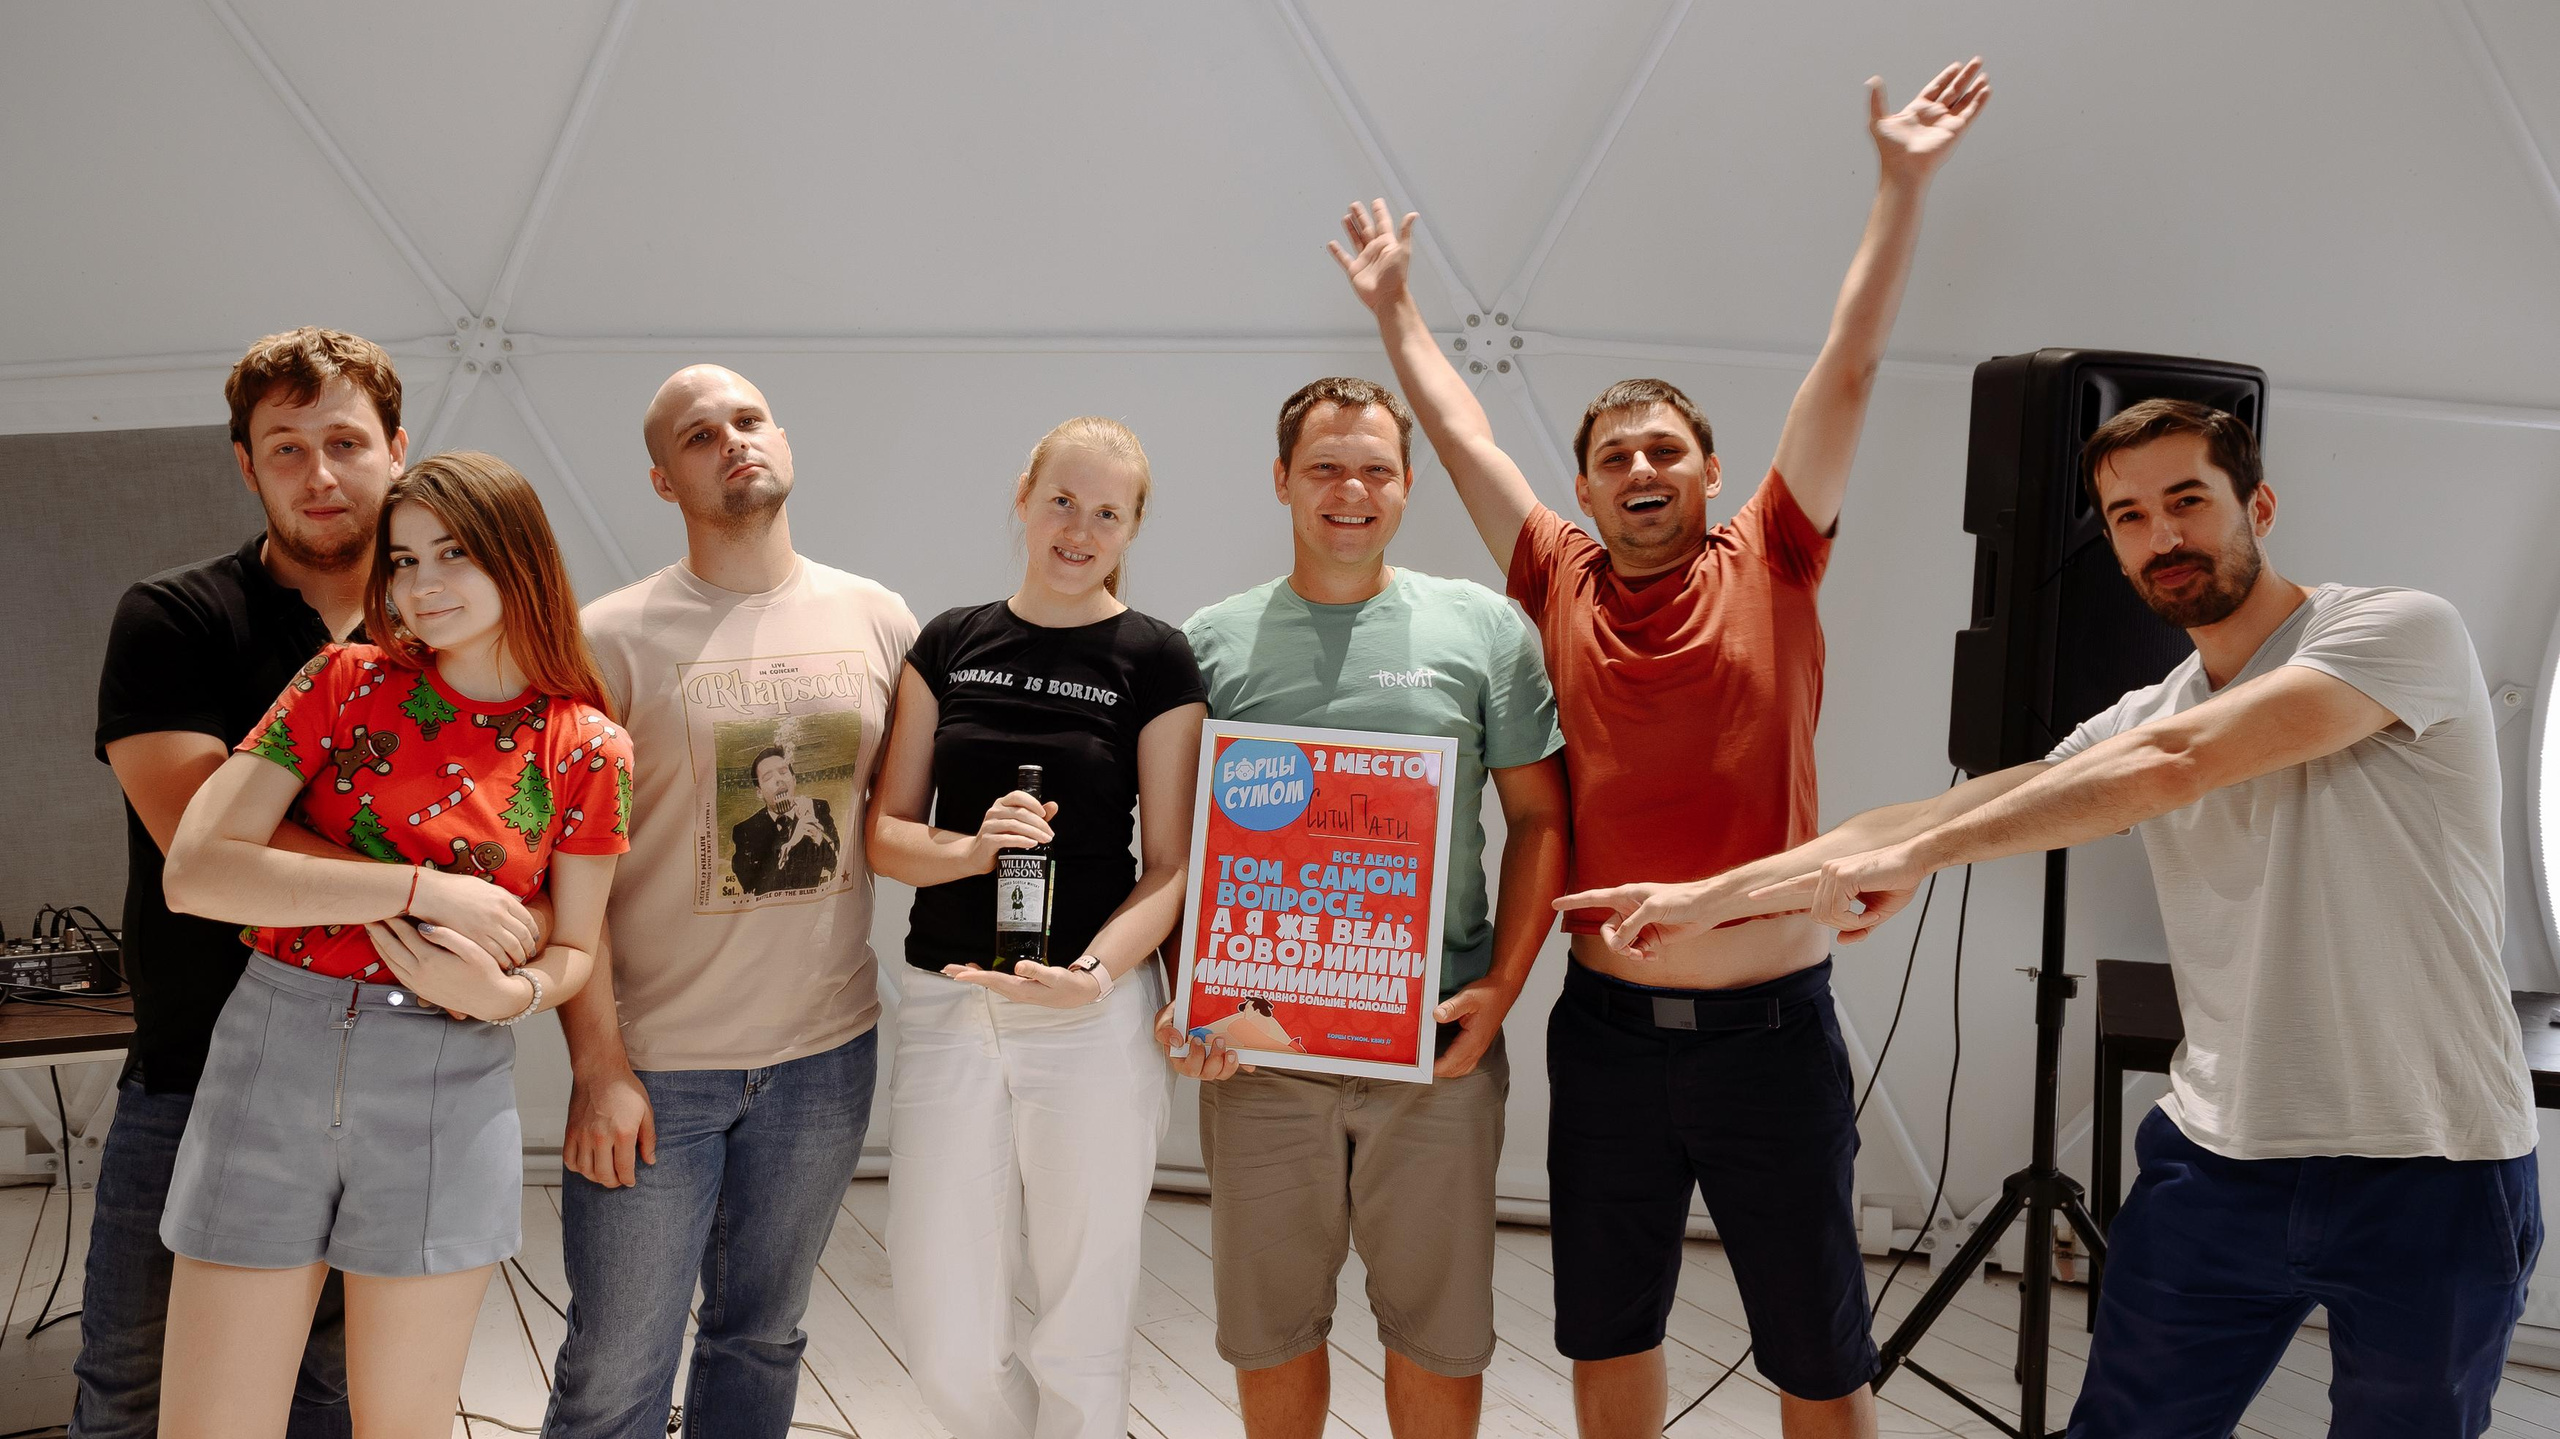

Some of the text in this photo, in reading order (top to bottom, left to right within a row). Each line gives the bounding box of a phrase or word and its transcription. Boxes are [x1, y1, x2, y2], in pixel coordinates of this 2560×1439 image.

[687, 660, 864, 715] Rhapsody
[949, 669, 1118, 706] NORMAL IS BORING
[1313, 750, 1426, 779] 2 МЕСТО
[1224, 779, 1304, 810] СУМОМ
[1000, 868, 1043, 878] LAWSON'S
[1001, 860, 1040, 869] WILLIAM
[1332, 851, 1418, 869] ВСЕ ДЕЛО В
[1218, 855, 1416, 897] ТОМ САМОМ
[1210, 908, 1412, 949] А Я ЖЕ ВЕДЬ
[1204, 985, 1220, 995] НО
[1222, 987, 1239, 997] МЫ
[1298, 995, 1347, 1009] БОЛЬШИЕ
[1348, 1000, 1407, 1014] МОЛОДЦЫ!
